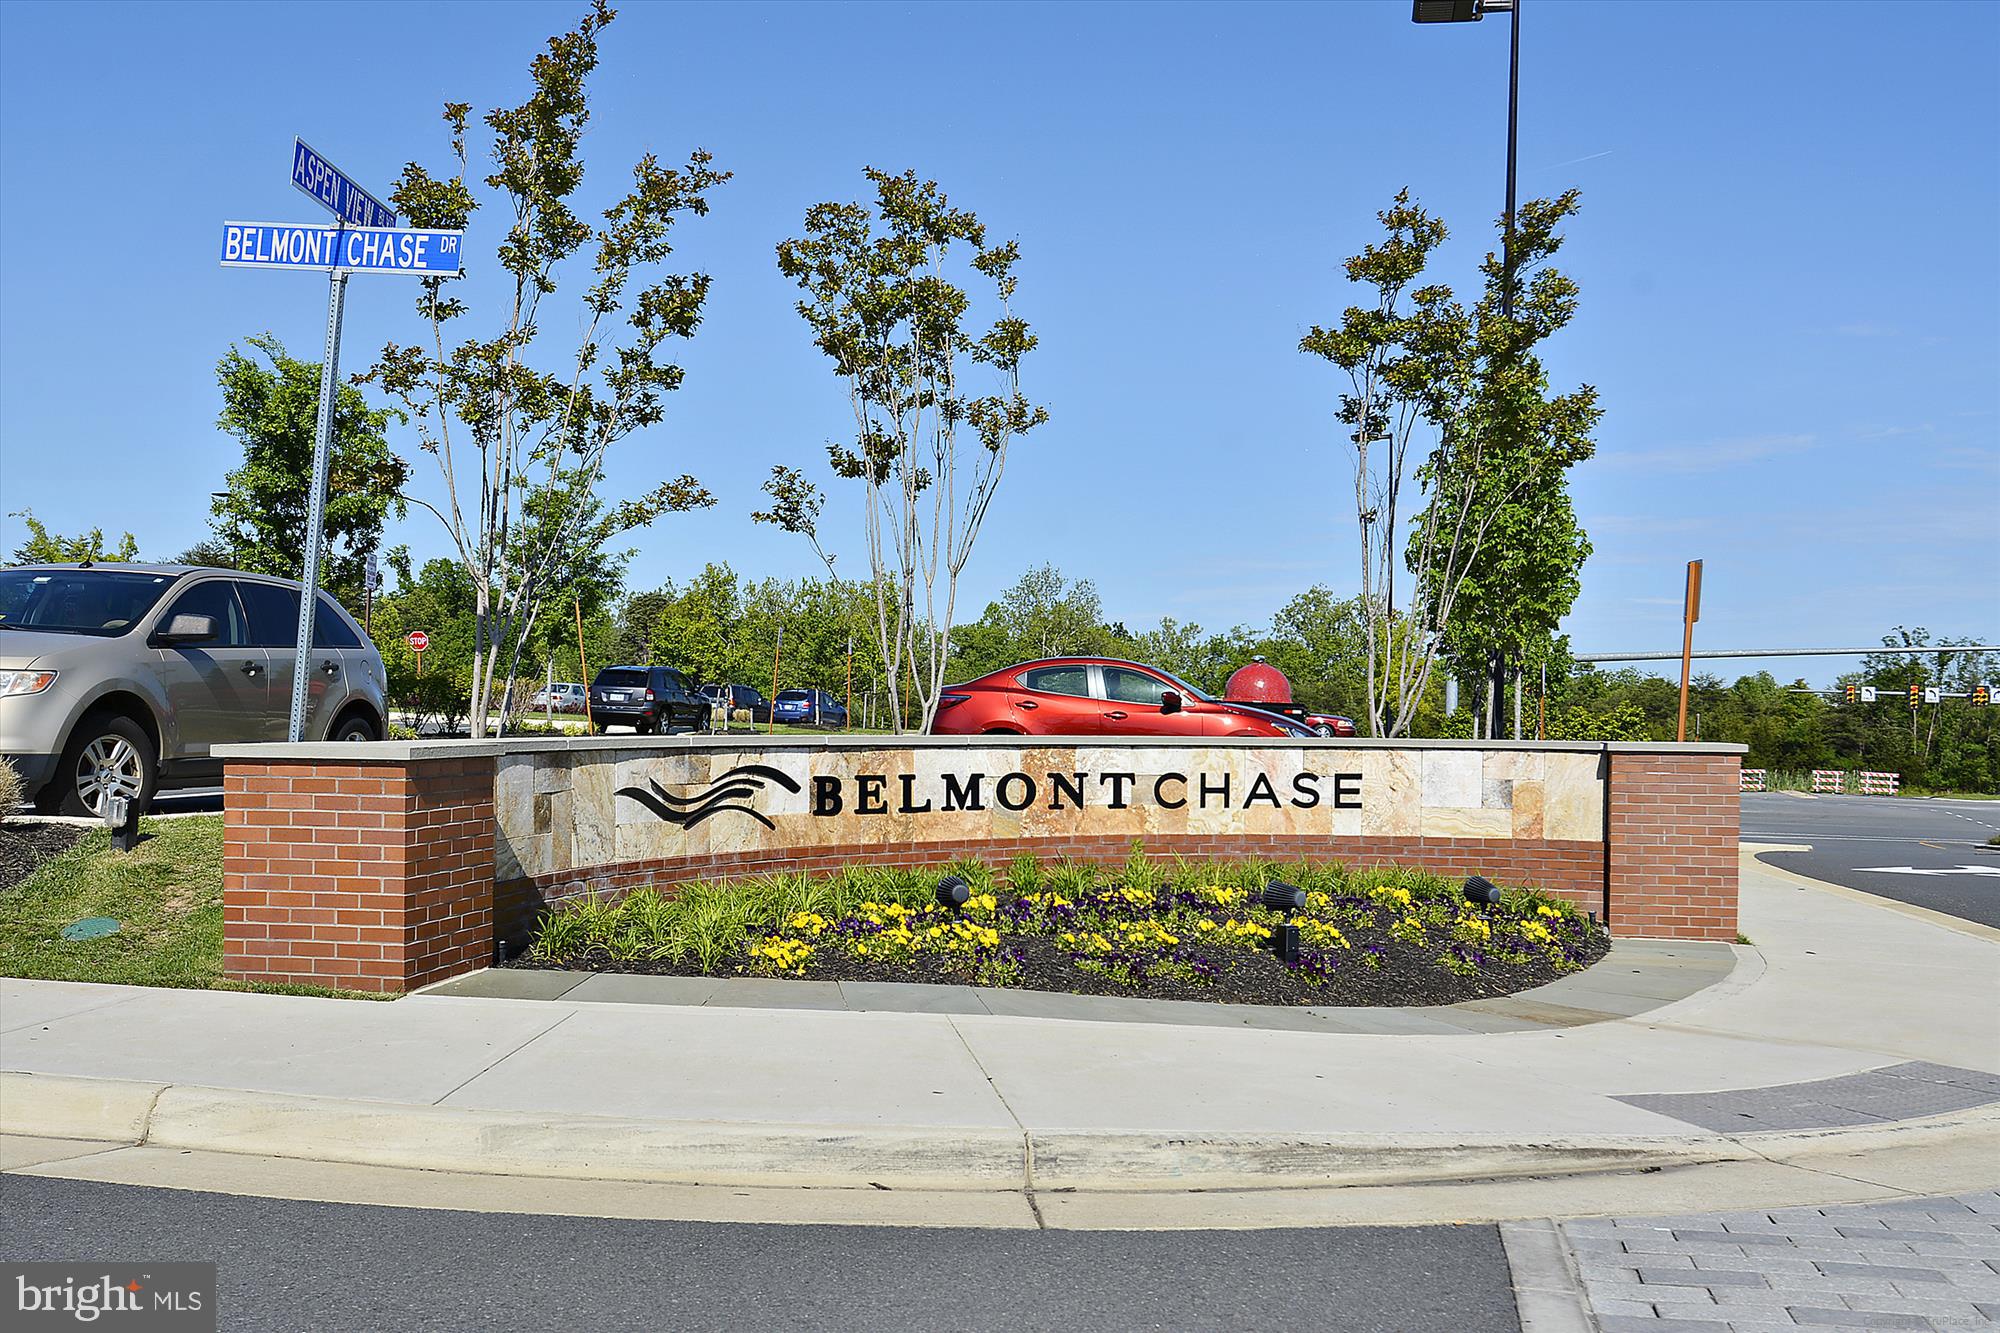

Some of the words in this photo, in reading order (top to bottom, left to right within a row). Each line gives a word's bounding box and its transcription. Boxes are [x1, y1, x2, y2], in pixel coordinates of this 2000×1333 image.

[295, 148, 341, 208] ASPEN
[346, 183, 375, 227] VIEW
[226, 227, 337, 264] BELMONT
[347, 232, 430, 268] CHASE
[440, 236, 457, 254] DR
[410, 637, 427, 645] STOP
[812, 772, 1136, 817] BELMONT
[1153, 772, 1363, 810] CHASE
